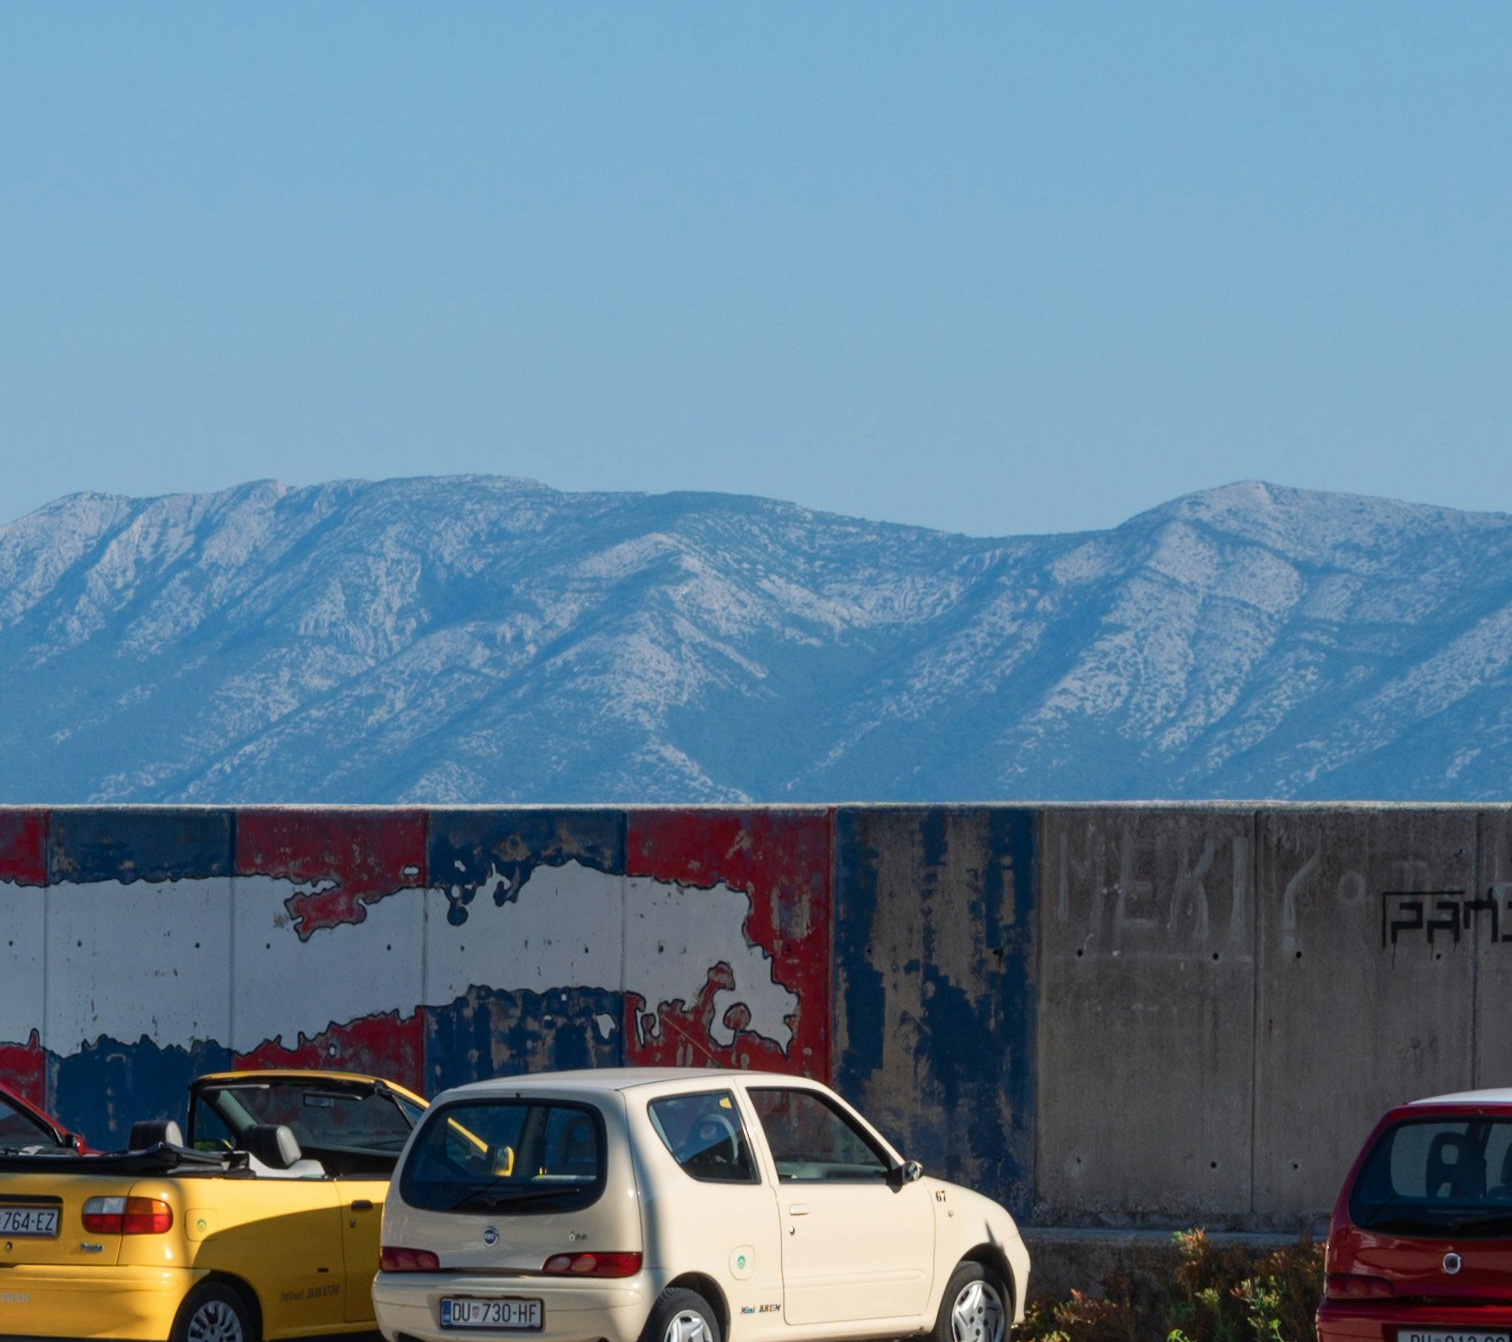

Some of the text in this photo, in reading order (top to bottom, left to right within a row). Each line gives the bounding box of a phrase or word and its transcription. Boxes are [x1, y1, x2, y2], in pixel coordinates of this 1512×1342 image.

[1, 1211, 55, 1232] 764-EZ
[452, 1304, 538, 1323] DU 730-HF
